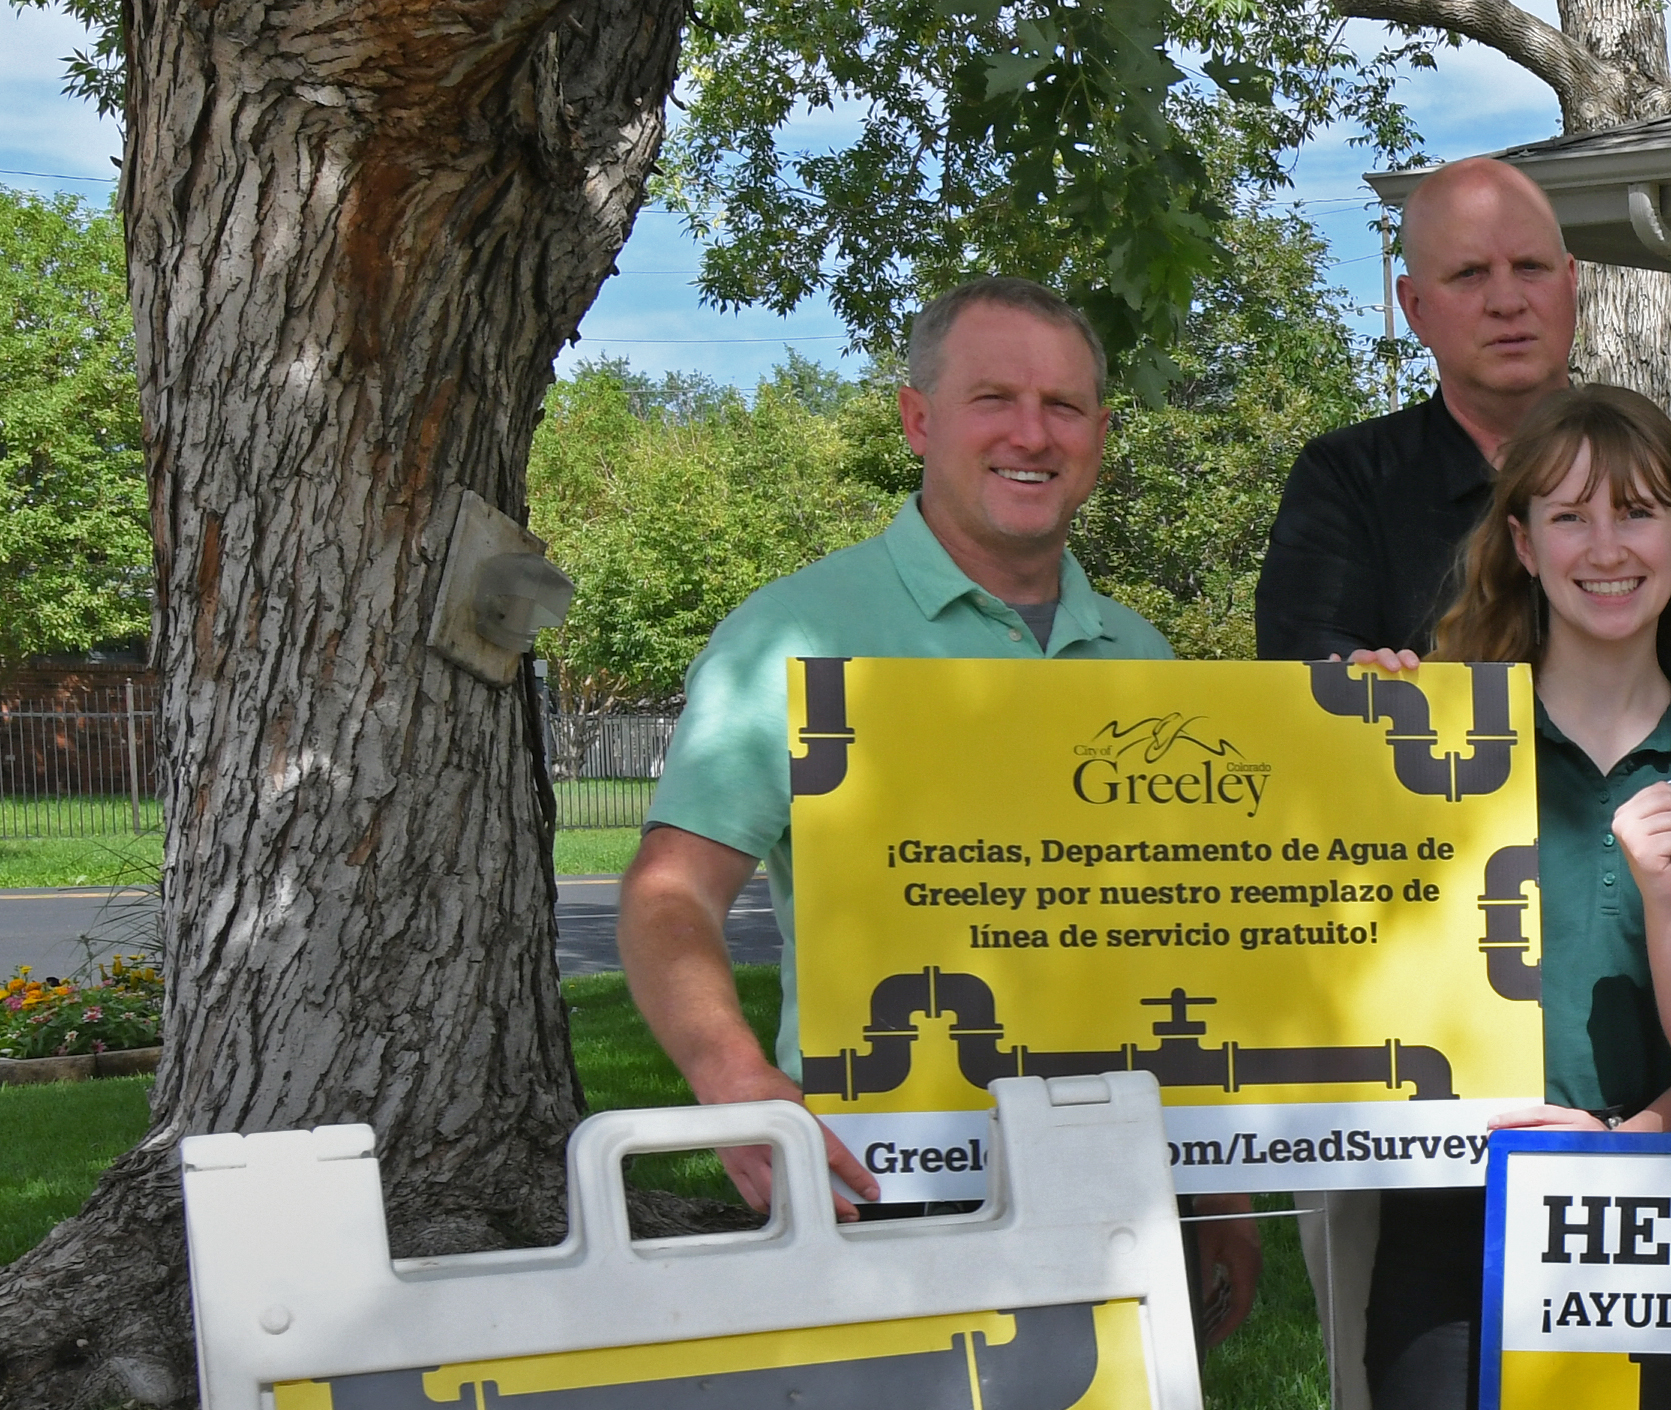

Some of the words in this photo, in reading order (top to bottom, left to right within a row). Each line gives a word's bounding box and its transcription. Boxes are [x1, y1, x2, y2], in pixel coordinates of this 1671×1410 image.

[1073, 759, 1271, 817] Greeley
[888, 839, 1030, 867] ¡Gracias,
[1040, 839, 1271, 866] Departamento
[1281, 838, 1319, 861] de
[1326, 838, 1408, 865] Agua
[1416, 837, 1454, 860] de
[904, 882, 1026, 909] Greeley
[1036, 886, 1090, 909] por
[1099, 882, 1220, 904] nuestro
[1230, 879, 1393, 907] reemplazo
[1402, 878, 1439, 902] de
[969, 923, 1049, 948] línea
[1059, 924, 1097, 947] de
[1106, 922, 1229, 946] servicio
[1239, 920, 1377, 949] gratuito!
